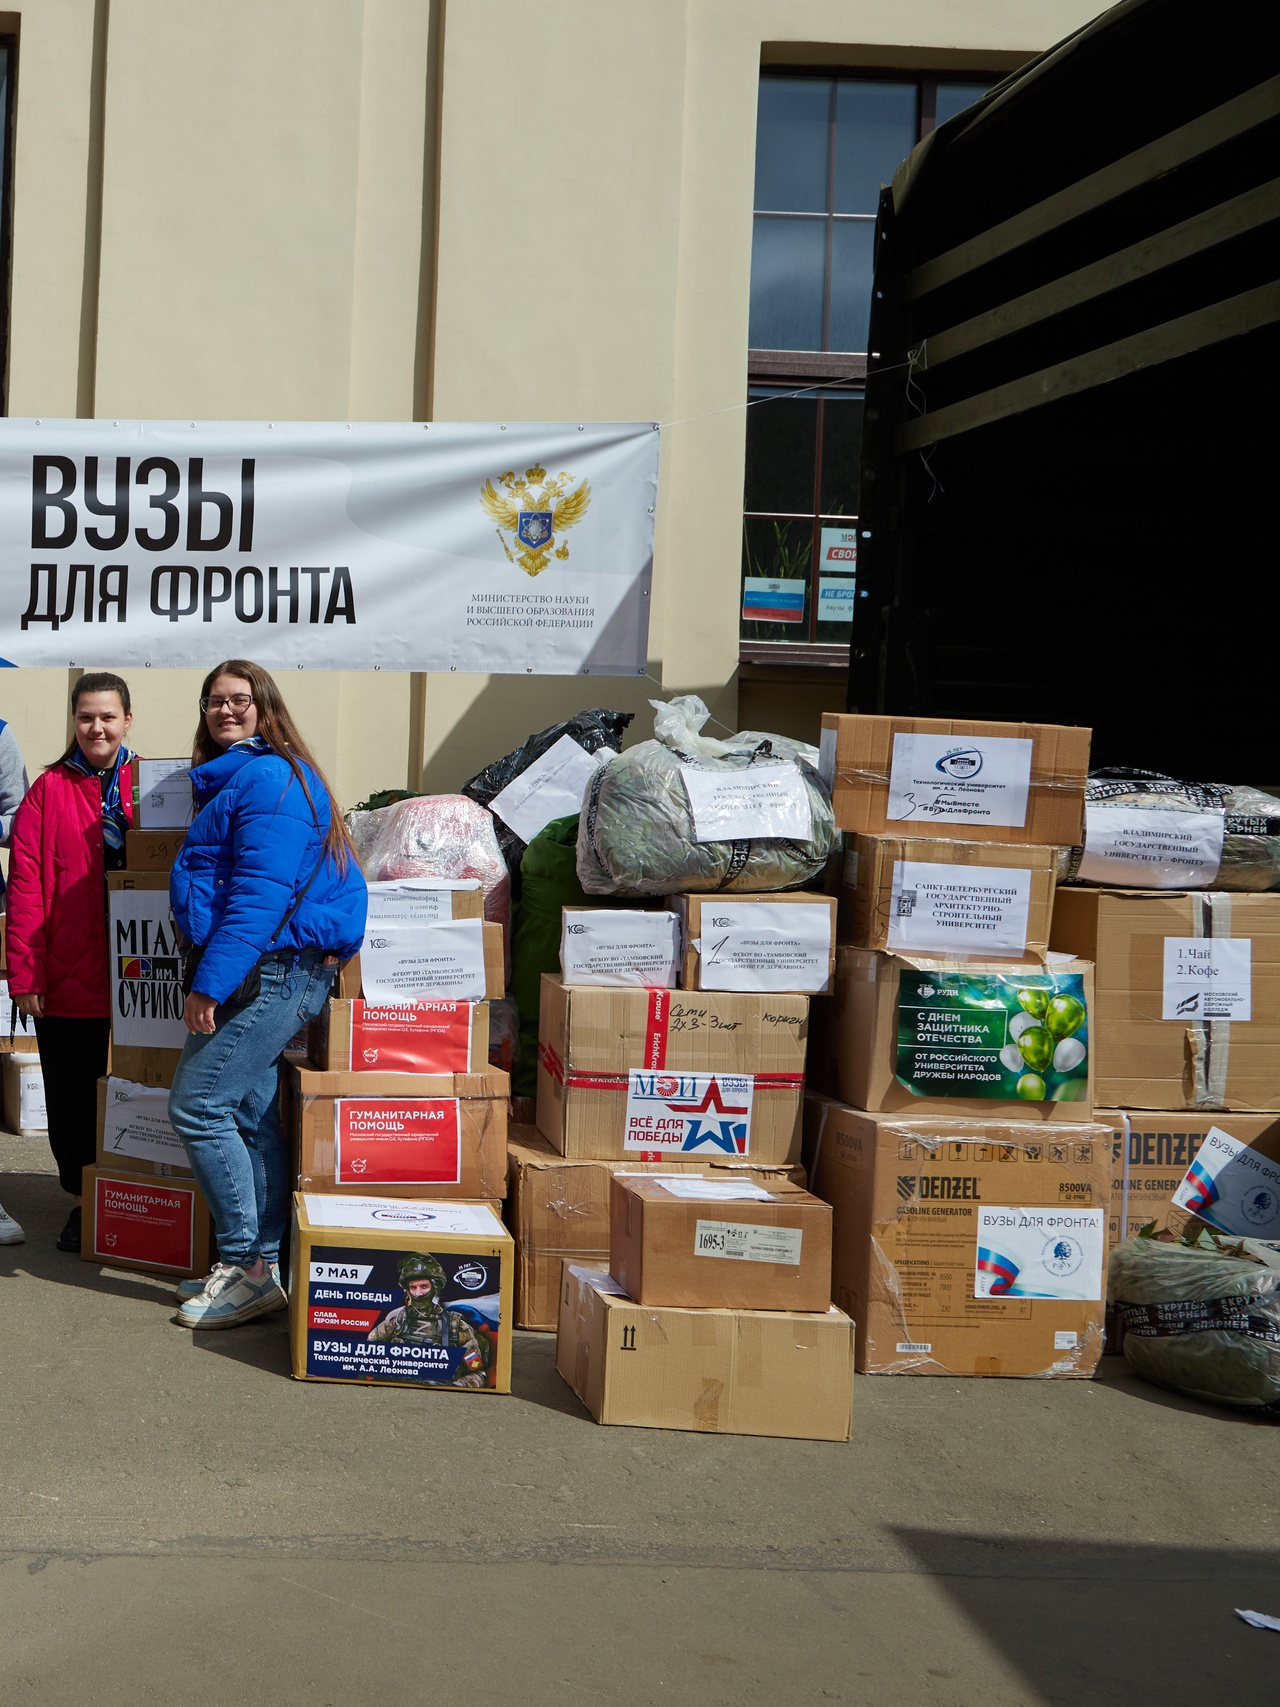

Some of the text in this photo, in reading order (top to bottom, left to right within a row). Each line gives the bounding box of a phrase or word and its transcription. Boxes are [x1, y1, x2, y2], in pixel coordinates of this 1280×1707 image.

[30, 455, 256, 552] ВУЗЫ
[20, 564, 356, 631] ДЛЯ ФРОНТА
[472, 594, 589, 604] МИНИСТЕРСТВО НАУКИ
[477, 606, 523, 614] ВЫСШЕГО
[526, 607, 595, 616] ОБРАЗОВАНИЯ
[467, 617, 593, 628] РОССИЙСКОЙ ФЕДЕРАЦИИ
[913, 779, 1006, 790] Технологический университет
[1123, 829, 1192, 841] ВЛАДИМИРСКИЙ
[1114, 840, 1198, 854] ГОСУДАРСТВЕННЫЙ
[1104, 851, 1206, 866] УНИВЕРСИТЕТ ФРОНТУ
[915, 883, 1017, 896] САНКТ-ПЕТЕРБУРГСКИЙ
[926, 893, 1012, 904] ГОСУДАРСТВЕННЫЙ
[933, 902, 1003, 913] АРХИТЕКТУРНО-
[932, 911, 1002, 922] СТРОИТЕЛЬНЫЙ
[936, 920, 997, 930] УНИВЕРСИТЕТ
[156, 968, 176, 980] им.
[363, 1012, 417, 1022] ПОМОЩЬ
[928, 1013, 961, 1022] ДНЕМ
[917, 1023, 990, 1034] ЗАЩИТНИКА
[917, 1033, 982, 1044] ОТЕЧЕСТВА
[930, 1052, 997, 1063] РОССИЙСКОГО
[915, 1062, 985, 1071] УНИВЕРСИТЕТА
[913, 1071, 1002, 1081] ДРУЖБЫ НАРОДОВ
[633, 1074, 698, 1097] МЭИ
[722, 1077, 748, 1087] ВУЗЫ
[350, 1111, 444, 1120] ГУМАНИТАРНАЯ
[350, 1122, 405, 1131] ПОМОЩЬ
[630, 1116, 684, 1131] ВСЁ ДЛЯ
[628, 1132, 683, 1144] ПОБЕДЫ
[1129, 1133, 1208, 1165] DENZE
[1210, 1136, 1261, 1171] ВУЗЫ ДЛЯ
[919, 1176, 981, 1199] DENZEL
[1059, 1183, 1091, 1192] 8500VA
[105, 1190, 180, 1209] ГУМАНИТАРНАЯ
[105, 1200, 148, 1213] ПОМОЩЬ
[932, 1208, 972, 1216] GENERATOR
[984, 1216, 1099, 1228] ВУЗЫ ДЛЯ ФРОНТА!
[699, 1233, 725, 1250] 1695-3
[316, 1267, 358, 1279] 9 МАЯ
[315, 1290, 392, 1302] ДЕНЬ ПОБЕДЫ
[341, 1319, 369, 1327] РОССИИ
[314, 1341, 449, 1360] ВУЗЫ ДЛЯ ФРОНТА
[314, 1354, 448, 1370] Технологический университет
[359, 1365, 378, 1373] А.А.
[380, 1367, 419, 1376] Леонова
